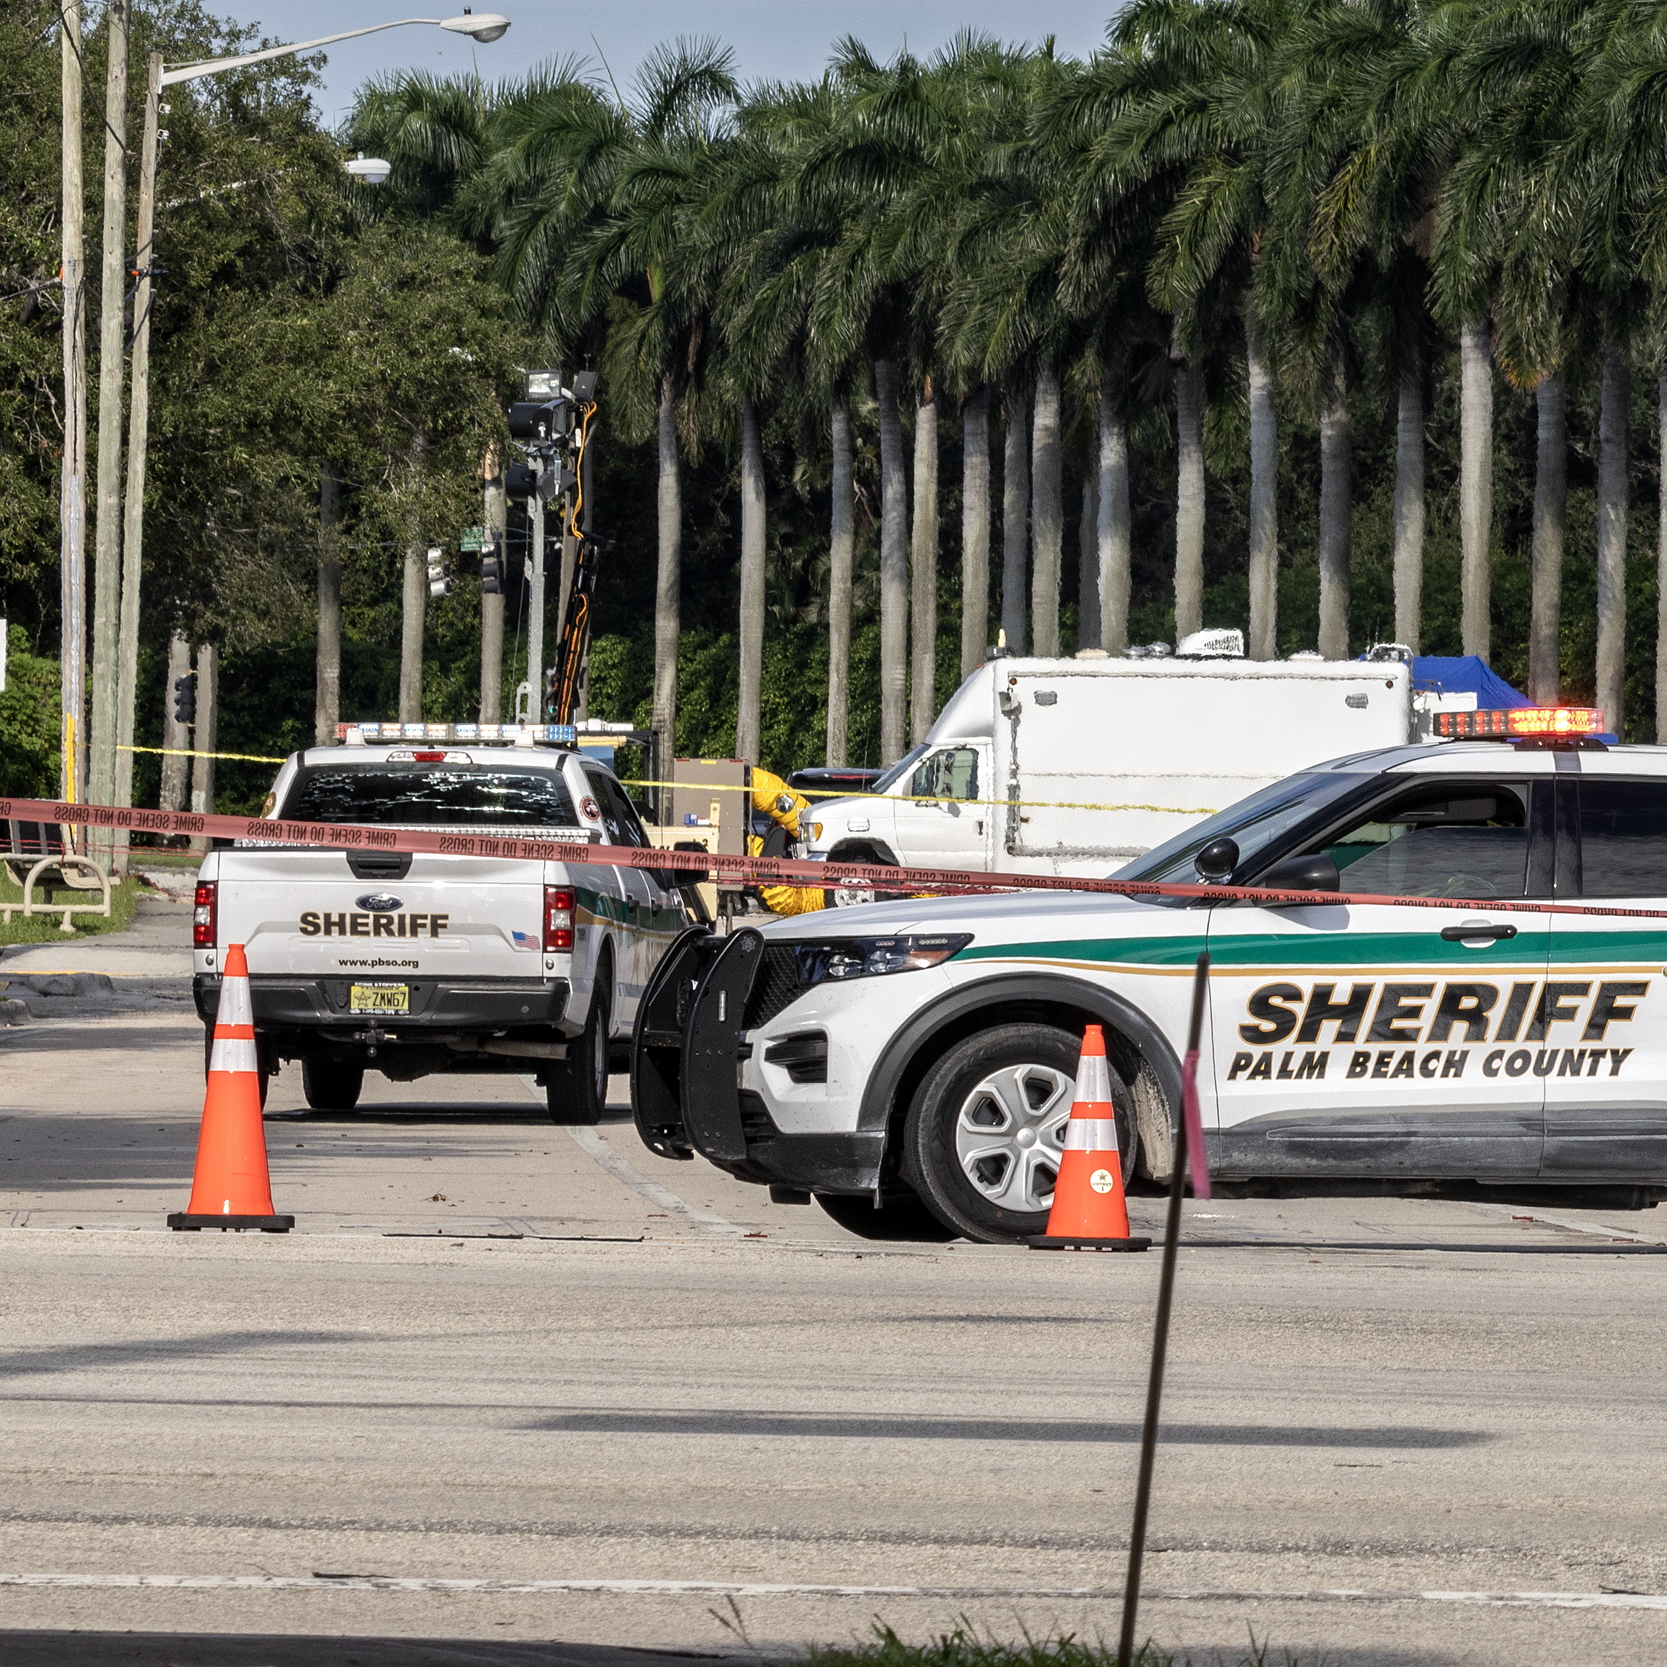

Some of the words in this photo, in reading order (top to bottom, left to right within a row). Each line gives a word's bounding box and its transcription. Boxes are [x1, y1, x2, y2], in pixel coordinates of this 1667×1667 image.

[366, 896, 393, 909] Ford
[299, 911, 449, 938] SHERIFF
[338, 958, 419, 969] www.pbso.org
[372, 992, 406, 1007] ZMW67
[1237, 980, 1651, 1046] SHERIFF
[1227, 1050, 1331, 1081] PALM
[1345, 1049, 1471, 1080] BEACH
[1482, 1048, 1635, 1078] COUNTY
